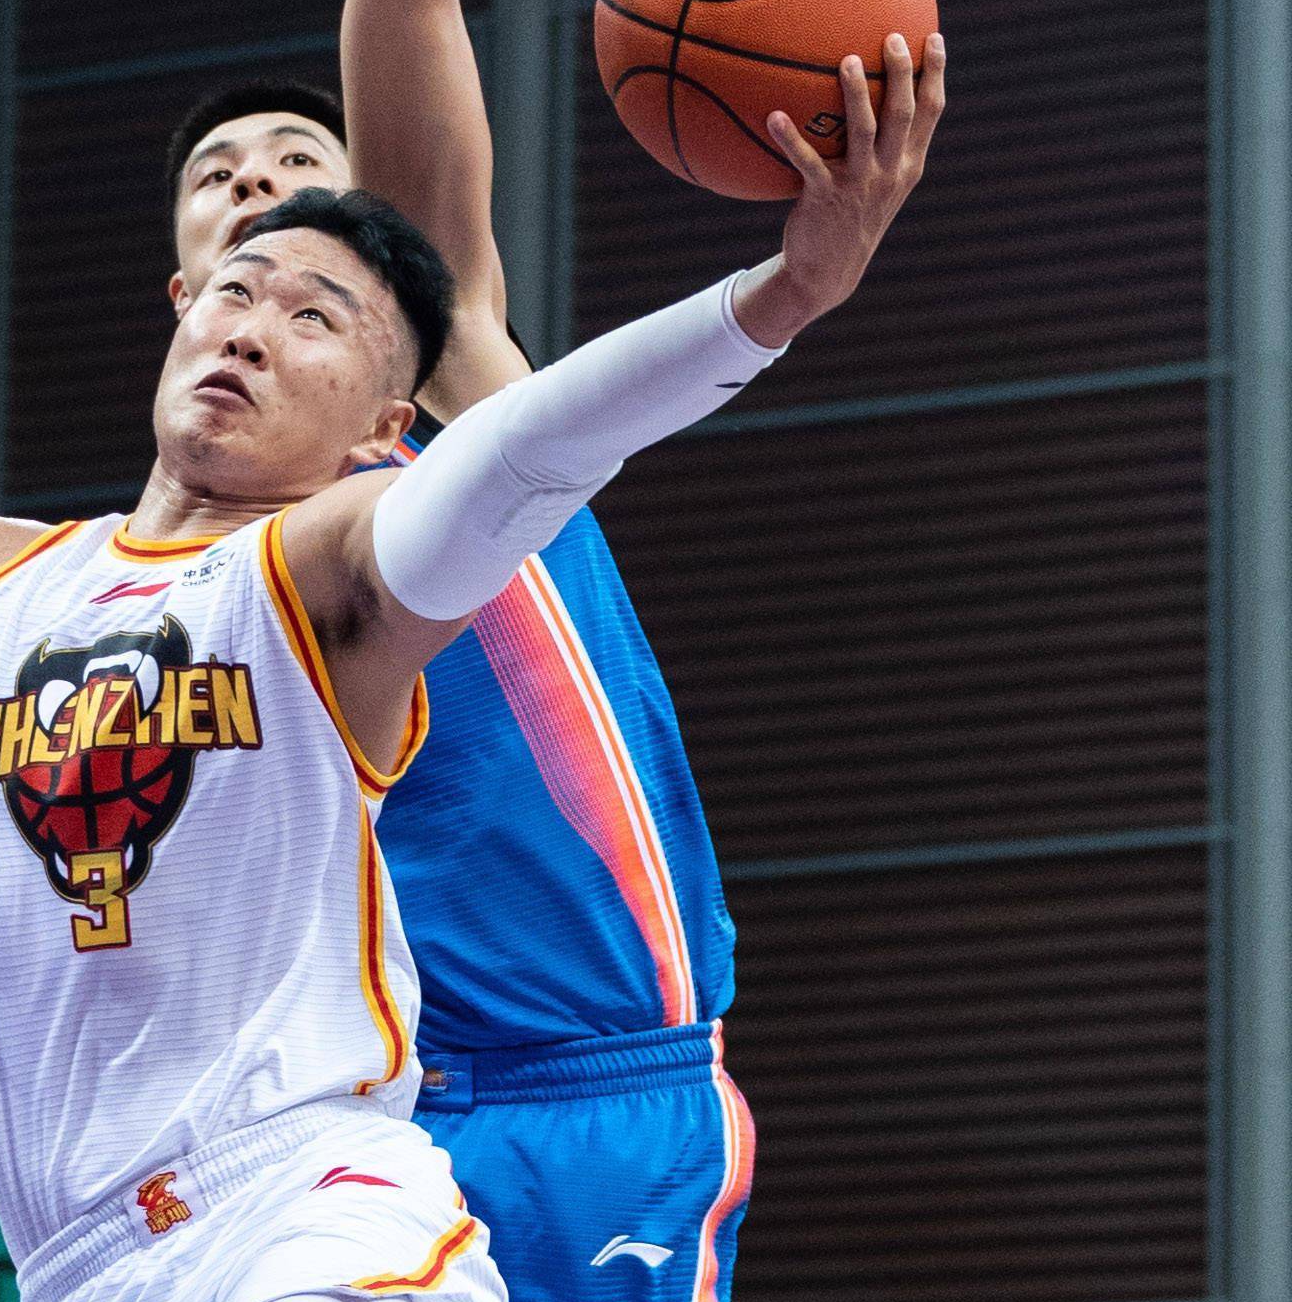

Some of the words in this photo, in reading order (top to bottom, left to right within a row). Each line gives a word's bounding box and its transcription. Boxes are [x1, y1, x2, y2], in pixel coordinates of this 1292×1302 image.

[183, 551, 235, 579] 中国人
[70, 847, 132, 953] 3
